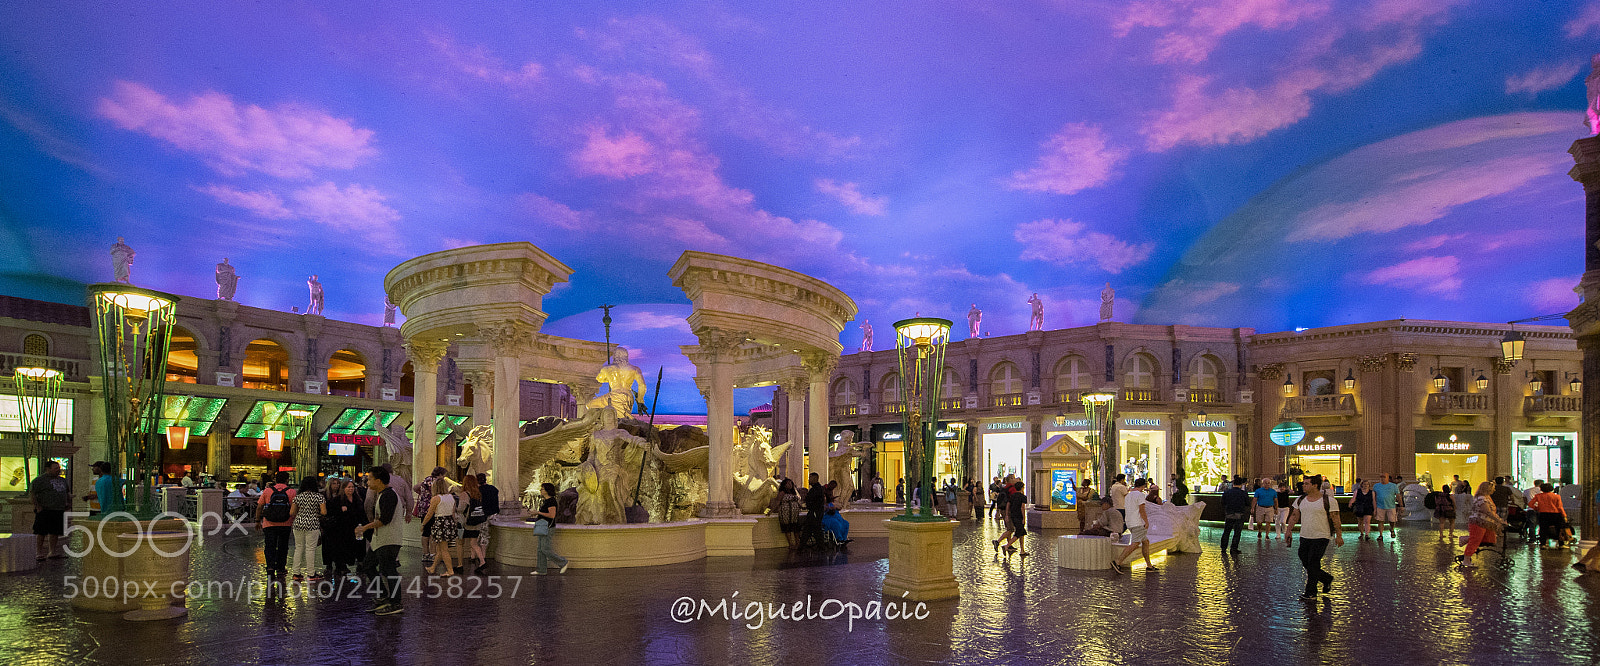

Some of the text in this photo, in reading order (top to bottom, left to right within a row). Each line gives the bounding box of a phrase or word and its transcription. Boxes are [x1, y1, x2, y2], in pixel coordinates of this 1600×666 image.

[1124, 418, 1161, 426] VERSACE
[882, 432, 902, 440] Cartier
[1536, 435, 1559, 446] Dior
[1436, 442, 1470, 450] MULBERRY
